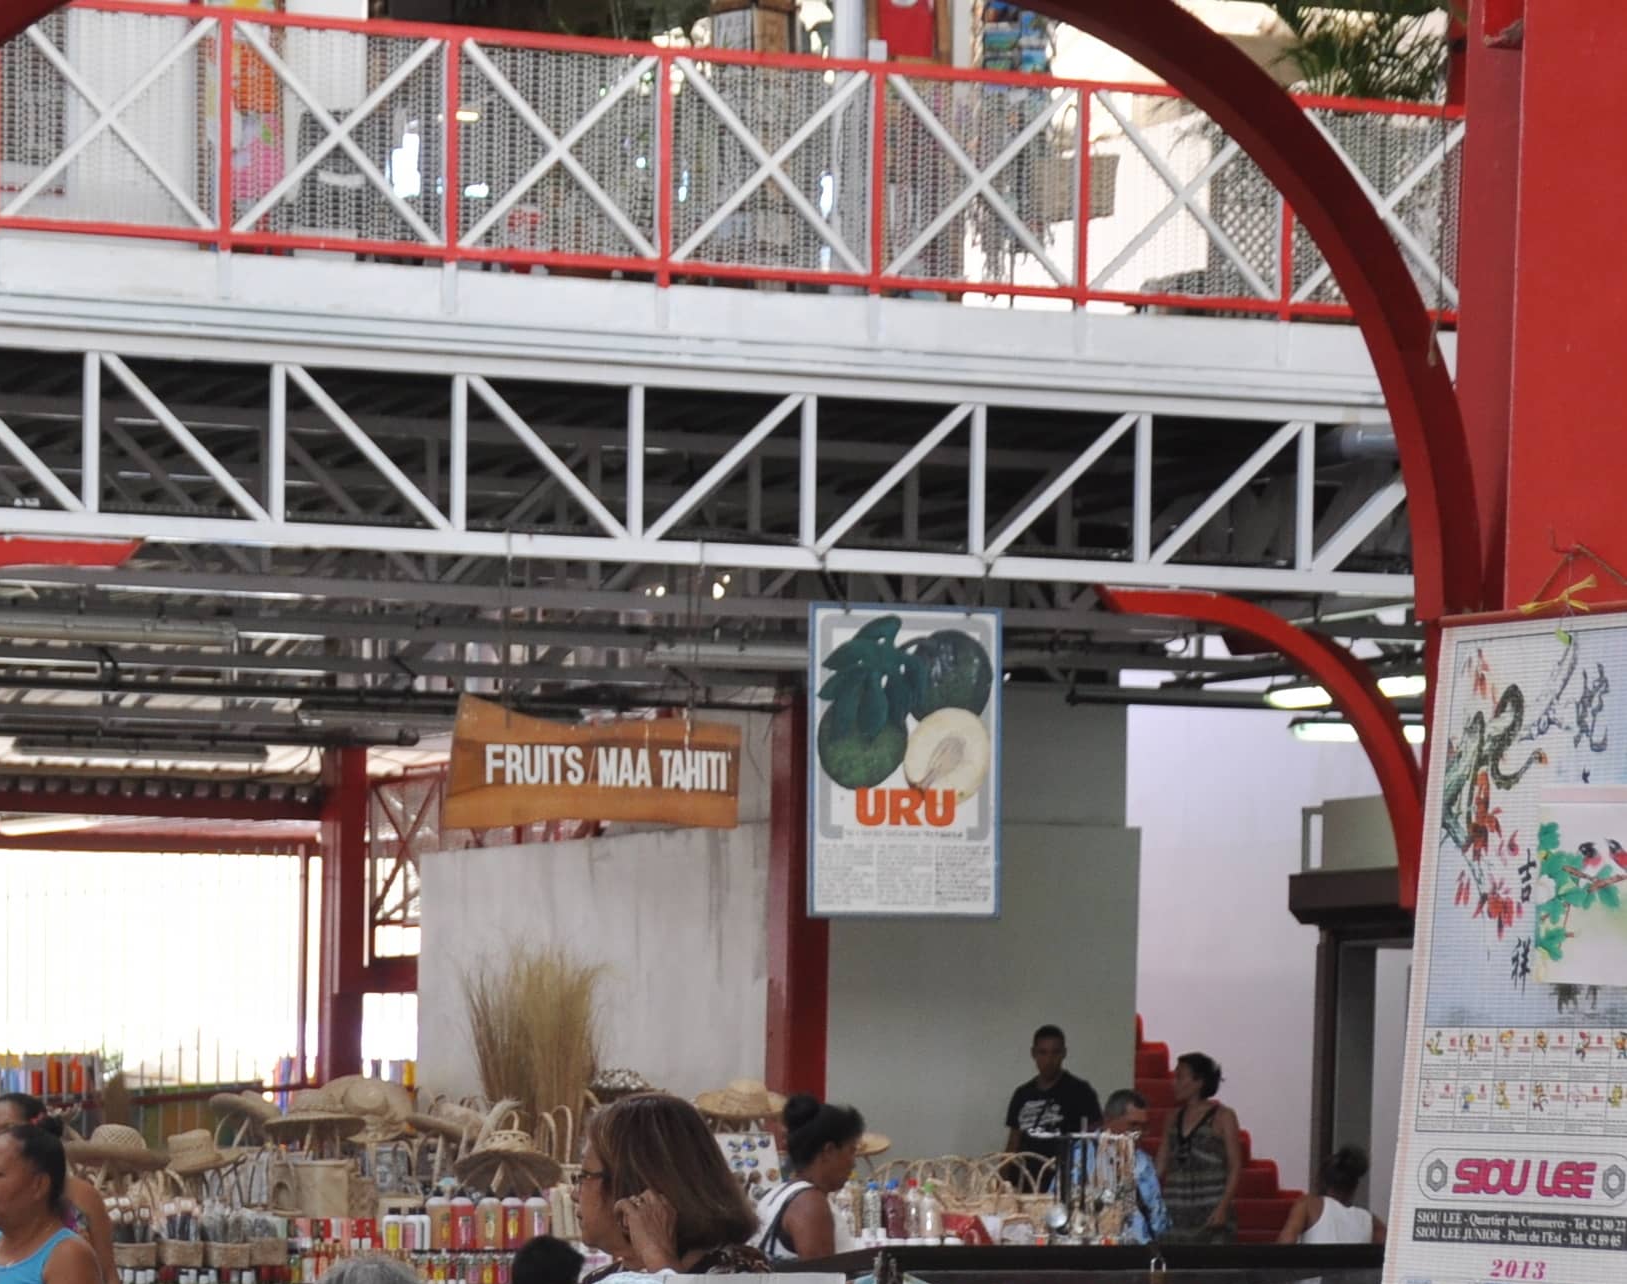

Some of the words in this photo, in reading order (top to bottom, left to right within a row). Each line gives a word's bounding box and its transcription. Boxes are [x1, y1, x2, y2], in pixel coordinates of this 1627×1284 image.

[484, 743, 586, 786] FRUITS
[597, 746, 653, 788] MAA
[854, 786, 956, 828] URU
[1451, 1157, 1531, 1197] SIOU
[1535, 1160, 1598, 1200] LEE
[1414, 1225, 1440, 1238] SIOU
[1441, 1227, 1462, 1239] LEE
[1462, 1227, 1501, 1242] JUNIOR
[1528, 1231, 1541, 1243] de
[1585, 1234, 1598, 1246] 42
[1416, 1211, 1442, 1224] SIOU
[1443, 1212, 1464, 1224] LEE
[1468, 1213, 1506, 1228] Quartier
[1507, 1215, 1521, 1227] du
[1520, 1215, 1567, 1230] Commerce
[1589, 1219, 1602, 1231] 42
[1601, 1219, 1615, 1232] 80
[1614, 1220, 1627, 1233] 22
[1489, 1258, 1547, 1280] 2013
